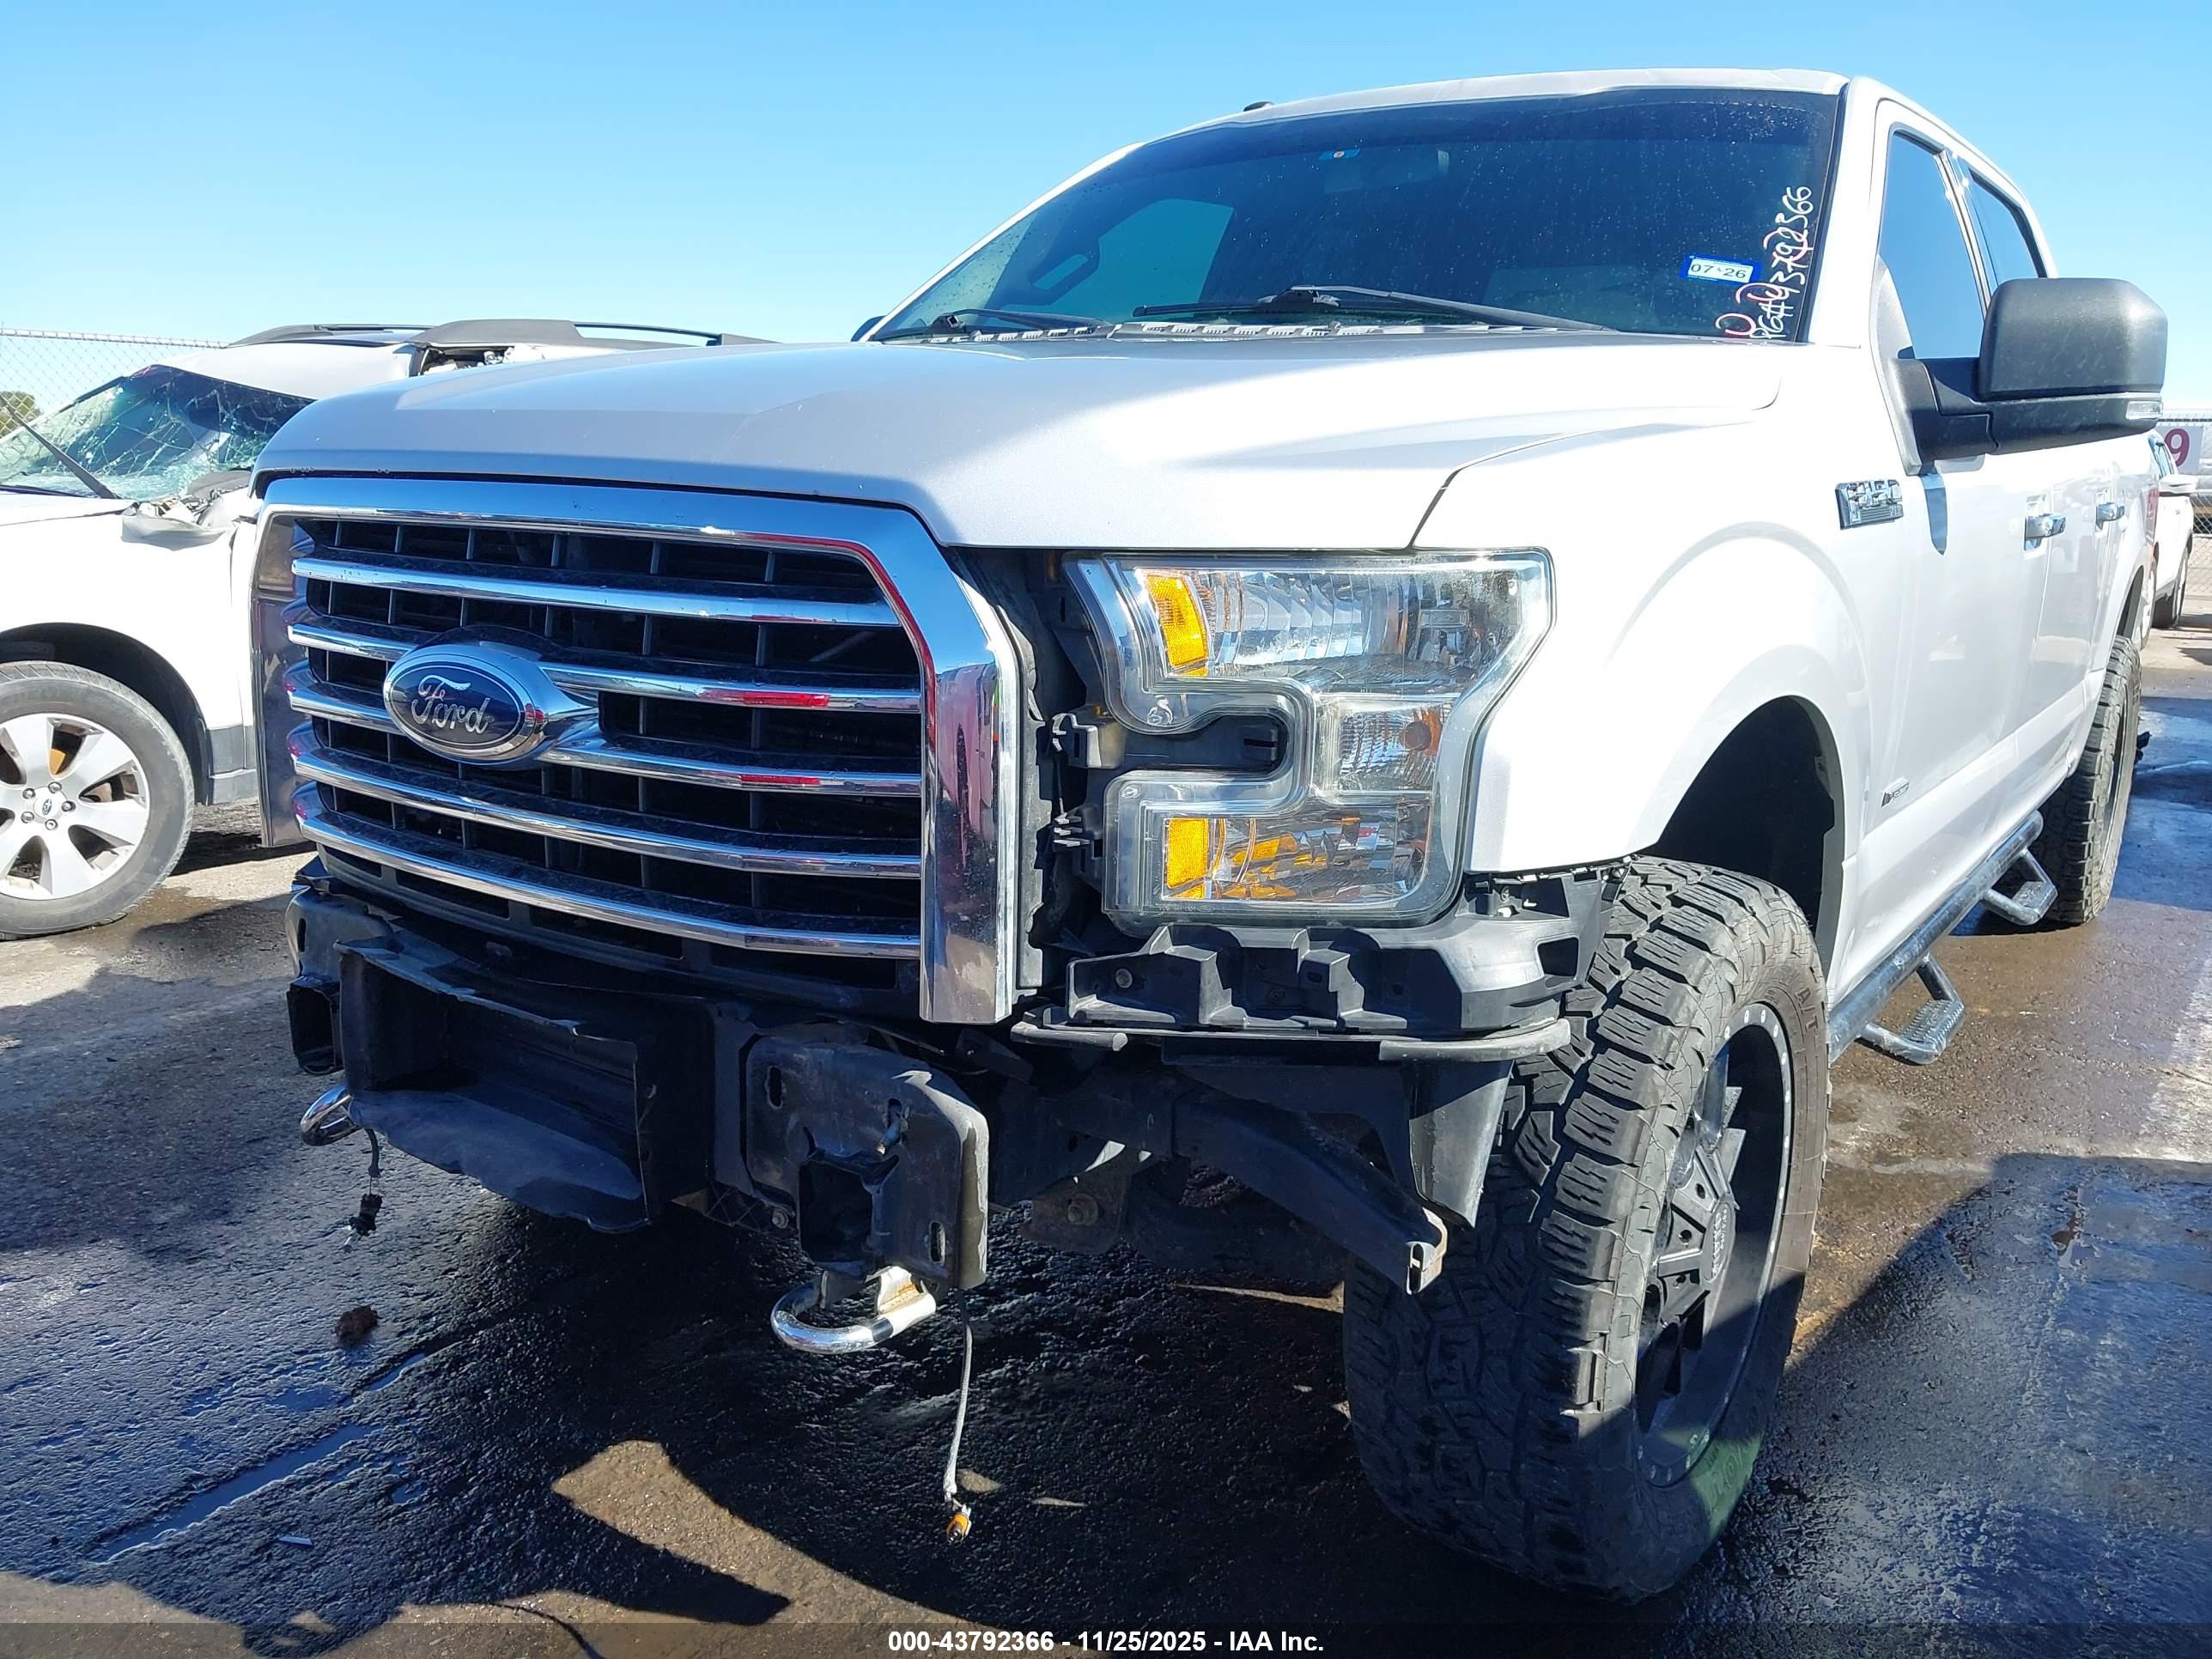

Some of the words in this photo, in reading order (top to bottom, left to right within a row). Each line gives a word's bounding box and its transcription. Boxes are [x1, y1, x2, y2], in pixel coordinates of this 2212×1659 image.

[1691, 263, 1715, 273] 07
[1723, 267, 1747, 279] 26
[2164, 428, 2190, 467] 9
[410, 674, 495, 734] Ford
